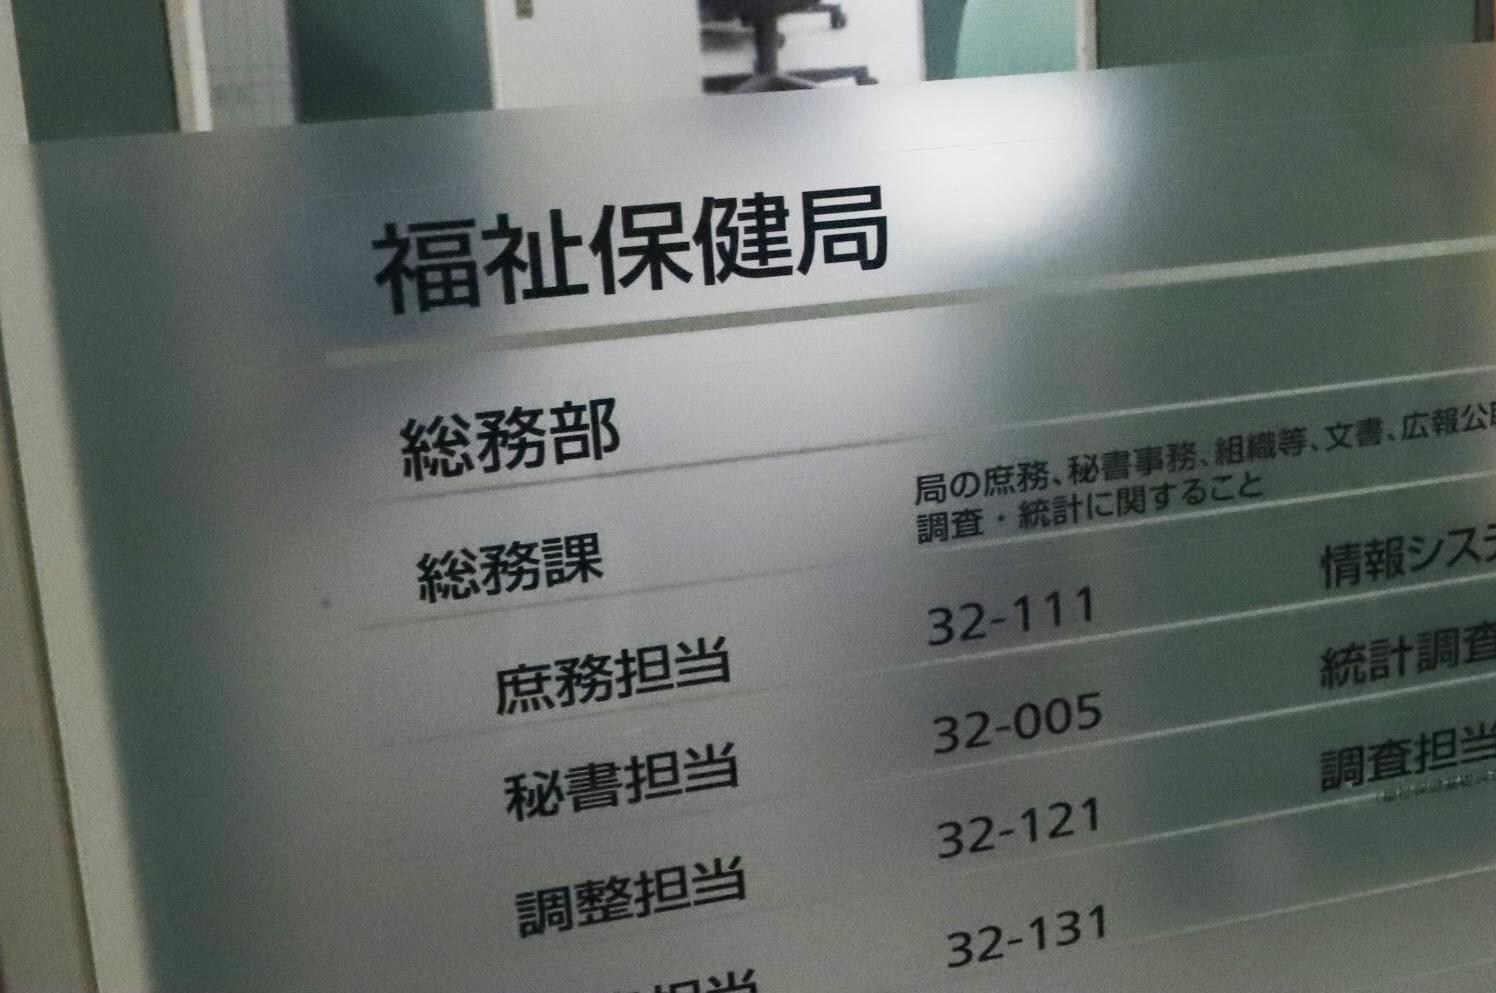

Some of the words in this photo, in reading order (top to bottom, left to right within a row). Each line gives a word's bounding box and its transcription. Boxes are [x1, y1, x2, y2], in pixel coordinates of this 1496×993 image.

[371, 185, 888, 315] 福祉保健局
[399, 397, 621, 482] 総務部
[916, 471, 1264, 545] 調査・統計に関すること
[416, 532, 605, 605] 総務課
[927, 585, 1095, 646] 32-111
[495, 635, 732, 716] 庶務担当
[932, 692, 1103, 755] 32-005
[504, 742, 740, 822] 秘書担当
[936, 797, 1101, 859] 32-121
[514, 855, 747, 939] 調整担当
[945, 904, 1109, 968] 32-131
